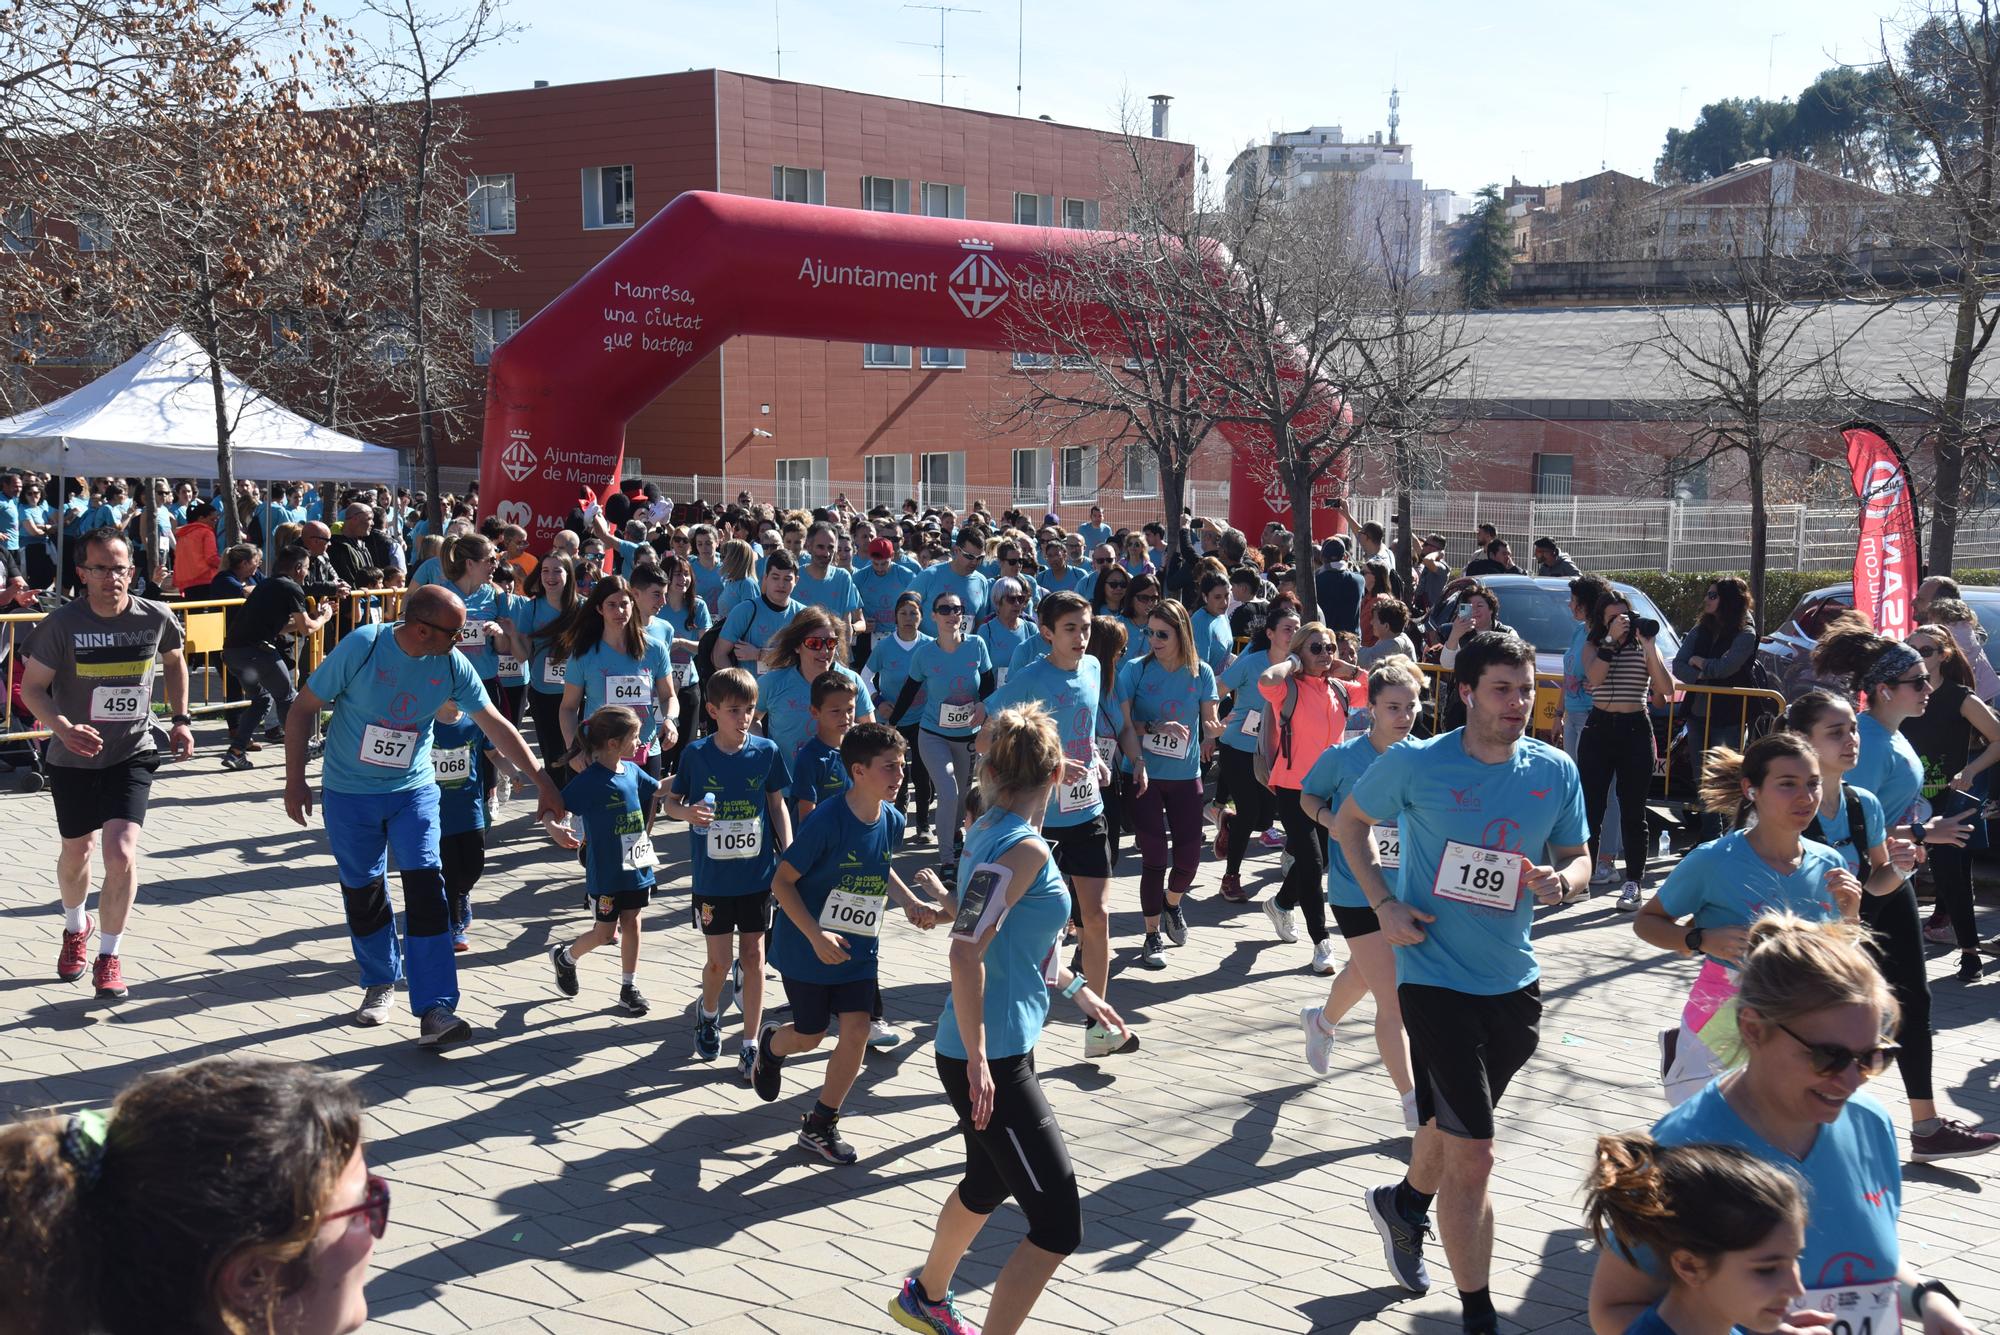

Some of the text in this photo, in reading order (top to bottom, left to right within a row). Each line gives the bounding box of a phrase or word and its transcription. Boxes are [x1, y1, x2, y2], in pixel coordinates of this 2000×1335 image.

[798, 257, 938, 292] Ajuntament
[1018, 277, 1045, 300] de
[614, 280, 695, 305] Manresa,
[604, 307, 703, 330] una ciutat
[603, 332, 693, 357] que batega
[543, 446, 617, 467] Ajuntament
[542, 465, 615, 486] de Manresa
[536, 514, 565, 529] MA
[535, 529, 556, 539] Cor
[462, 628, 478, 639] 54
[498, 662, 519, 671] 540
[551, 666, 566, 677] 55
[615, 685, 641, 698] 644
[104, 697, 137, 712] 459
[947, 711, 969, 722] 506
[373, 739, 407, 758] 557
[1151, 733, 1178, 750] 418
[432, 758, 466, 773] 1068
[1069, 782, 1093, 801] 402
[714, 832, 756, 850] 1056
[1379, 840, 1399, 857] 24
[628, 843, 651, 860] 1057
[1459, 864, 1505, 892] 189
[831, 903, 877, 927] 1060
